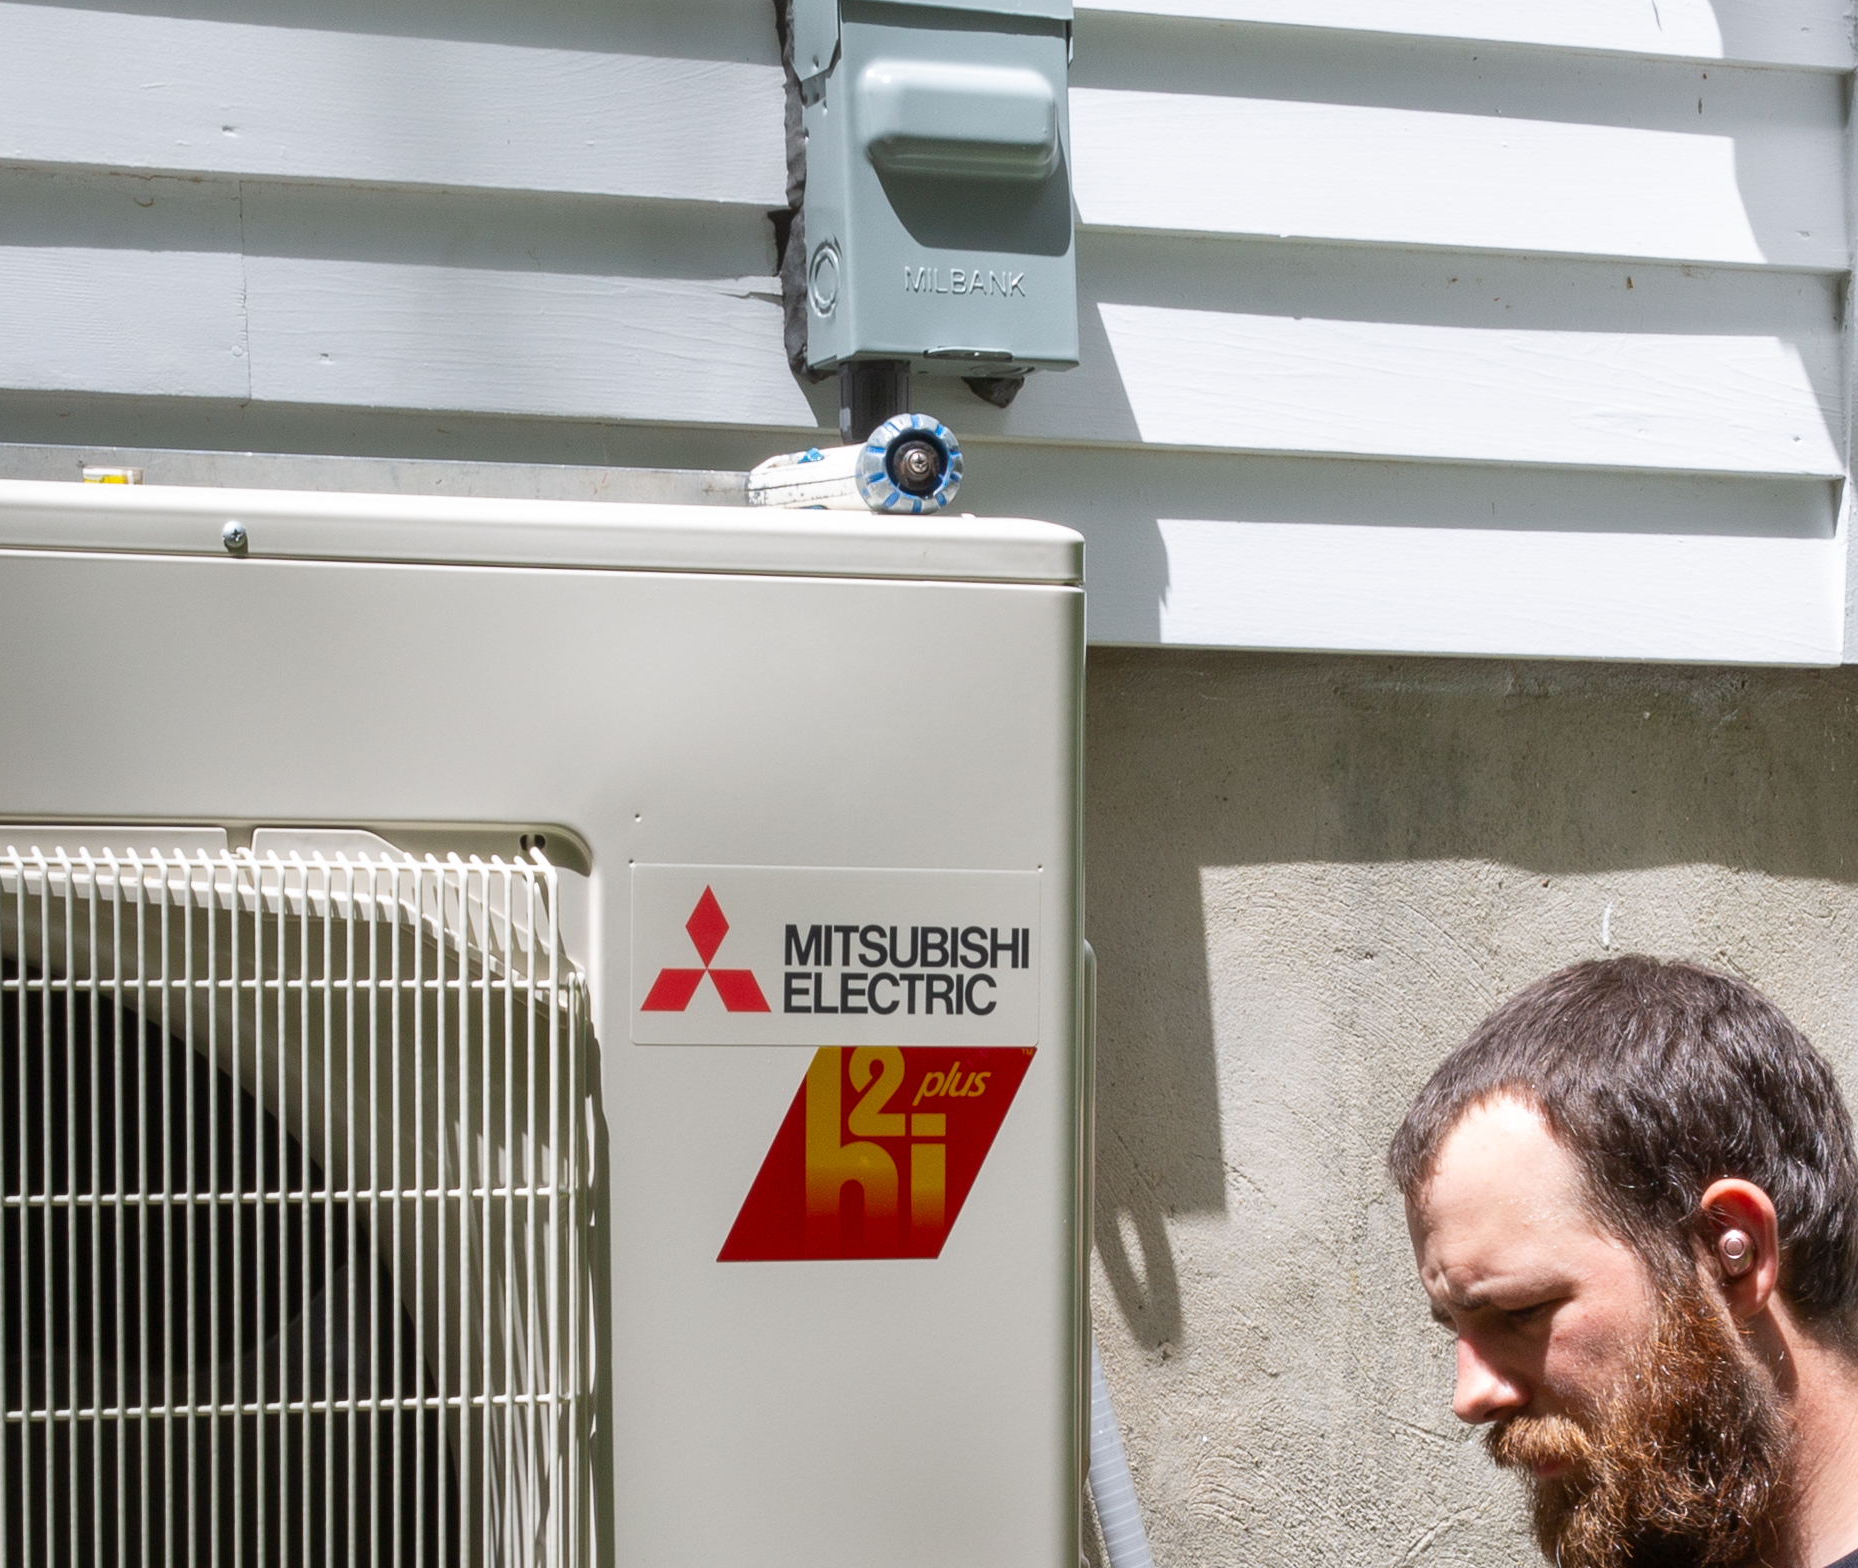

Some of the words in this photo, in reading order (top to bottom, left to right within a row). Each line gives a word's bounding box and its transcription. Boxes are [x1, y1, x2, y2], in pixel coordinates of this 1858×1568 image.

[903, 265, 1026, 298] MILBANK
[784, 924, 1030, 969] MITSUBISHI
[783, 972, 998, 1016] ELECTRIC
[911, 1061, 992, 1107] plus
